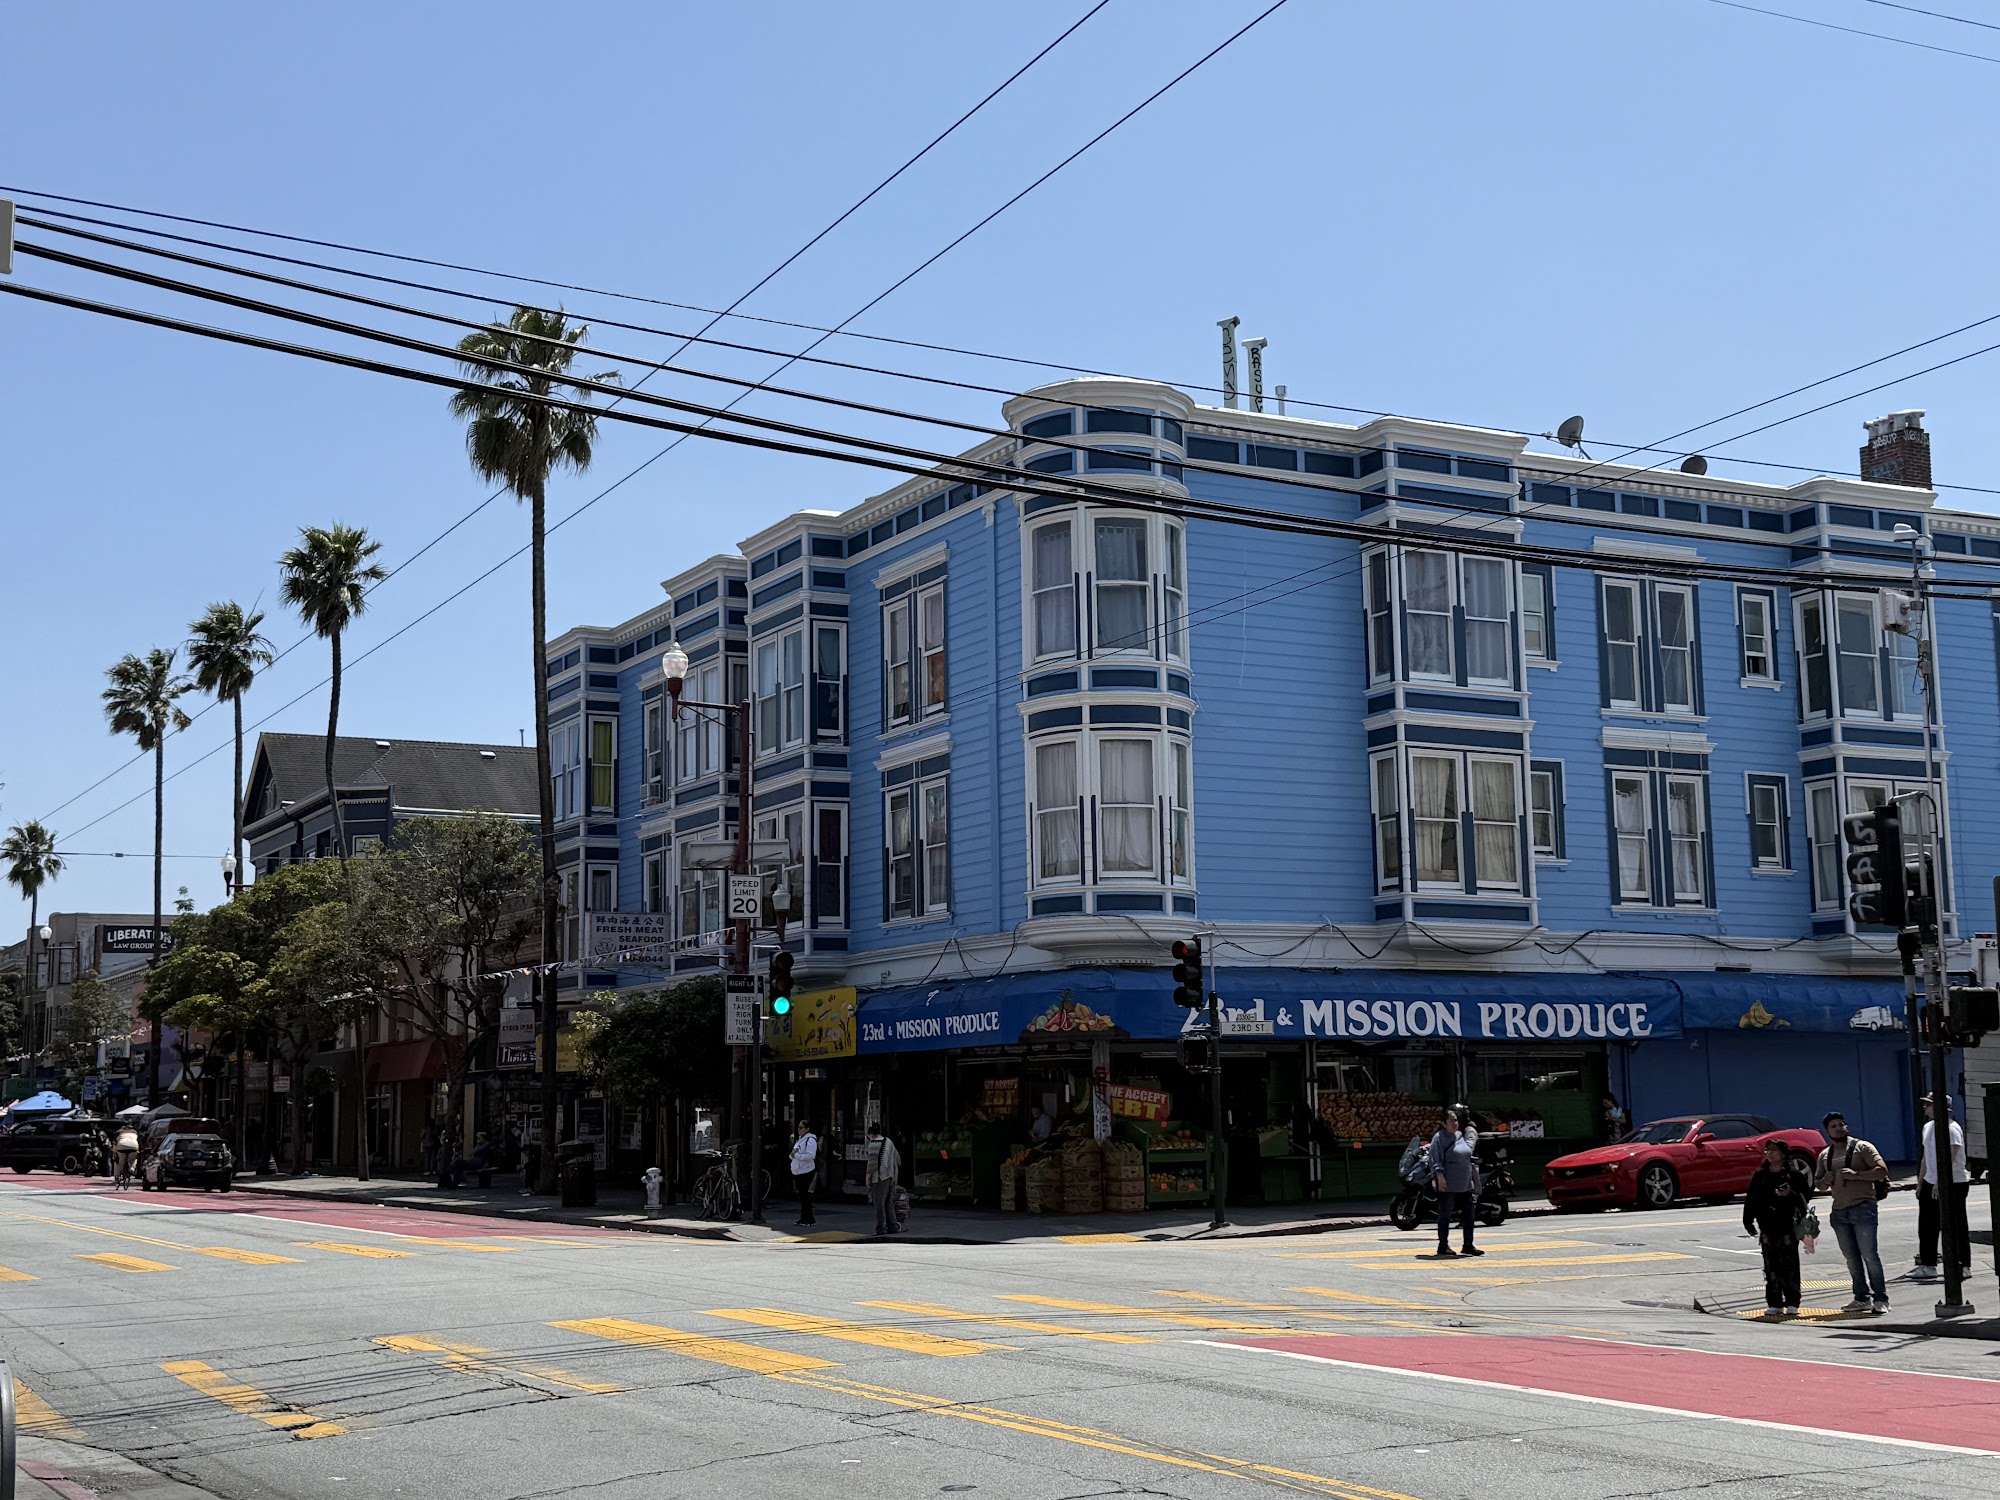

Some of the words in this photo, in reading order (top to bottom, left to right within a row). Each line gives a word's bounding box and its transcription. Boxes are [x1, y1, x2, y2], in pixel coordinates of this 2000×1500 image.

[731, 880, 760, 888] SPEED
[734, 888, 756, 896] LIMIT
[732, 897, 758, 914] 20
[107, 929, 172, 943] LIBERATIN
[596, 925, 632, 934] FRESH
[635, 926, 665, 935] MEAT
[619, 935, 665, 944] SEAFOOD
[862, 1022, 885, 1041] 23rd
[895, 1017, 941, 1040] MISSION
[945, 1011, 1000, 1036] PRODUCE
[1276, 1006, 1294, 1026] &
[1300, 1000, 1462, 1037] MISSION
[1477, 1002, 1653, 1038] PRODUCE
[1231, 1023, 1252, 1032] 23RD
[1255, 1023, 1265, 1032] ST
[1110, 1086, 1124, 1098] WE
[1124, 1088, 1168, 1105] ACCEPT
[1111, 1097, 1161, 1120] EBT
